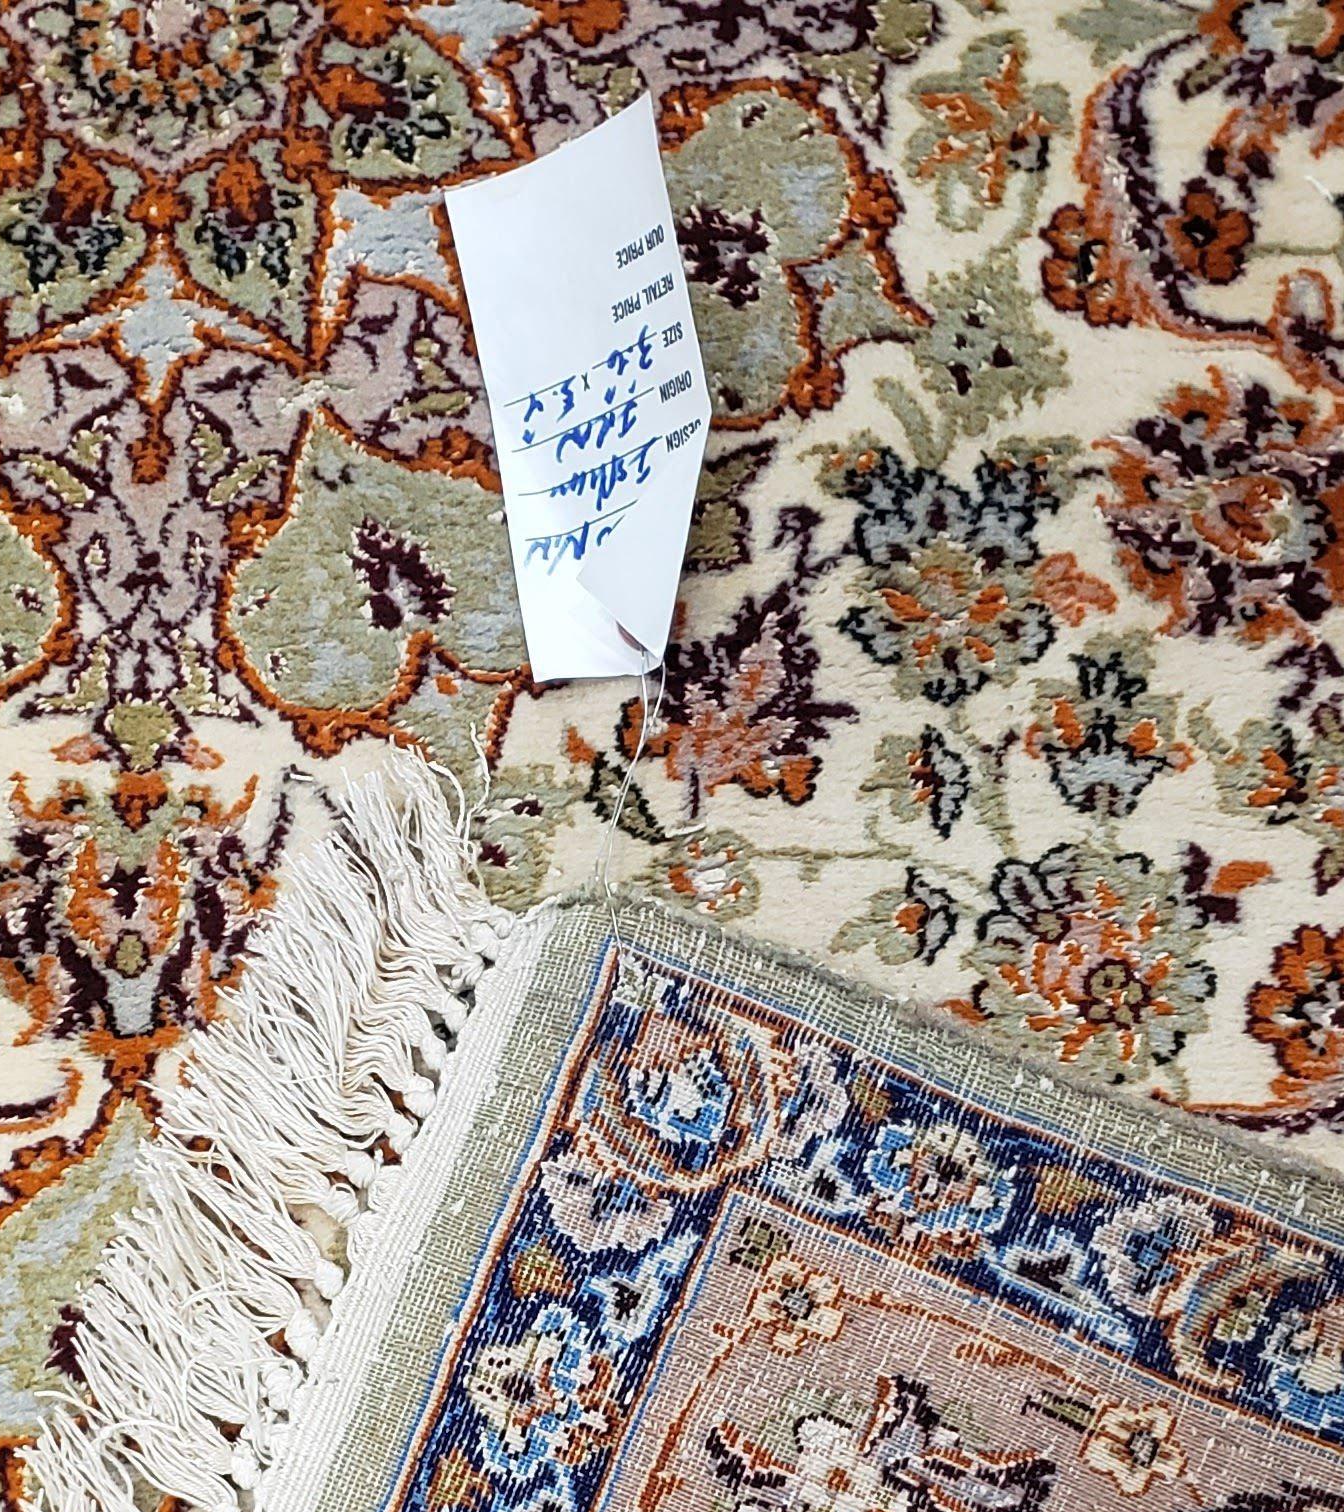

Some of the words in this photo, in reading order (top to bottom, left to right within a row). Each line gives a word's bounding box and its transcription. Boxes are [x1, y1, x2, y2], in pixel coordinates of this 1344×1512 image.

[644, 224, 664, 251] OUR
[615, 238, 644, 269] PRICE
[642, 272, 674, 305] RETAIL
[611, 292, 641, 323] PRICE
[662, 321, 683, 348] SIZE
[659, 370, 692, 403] ORIGIN
